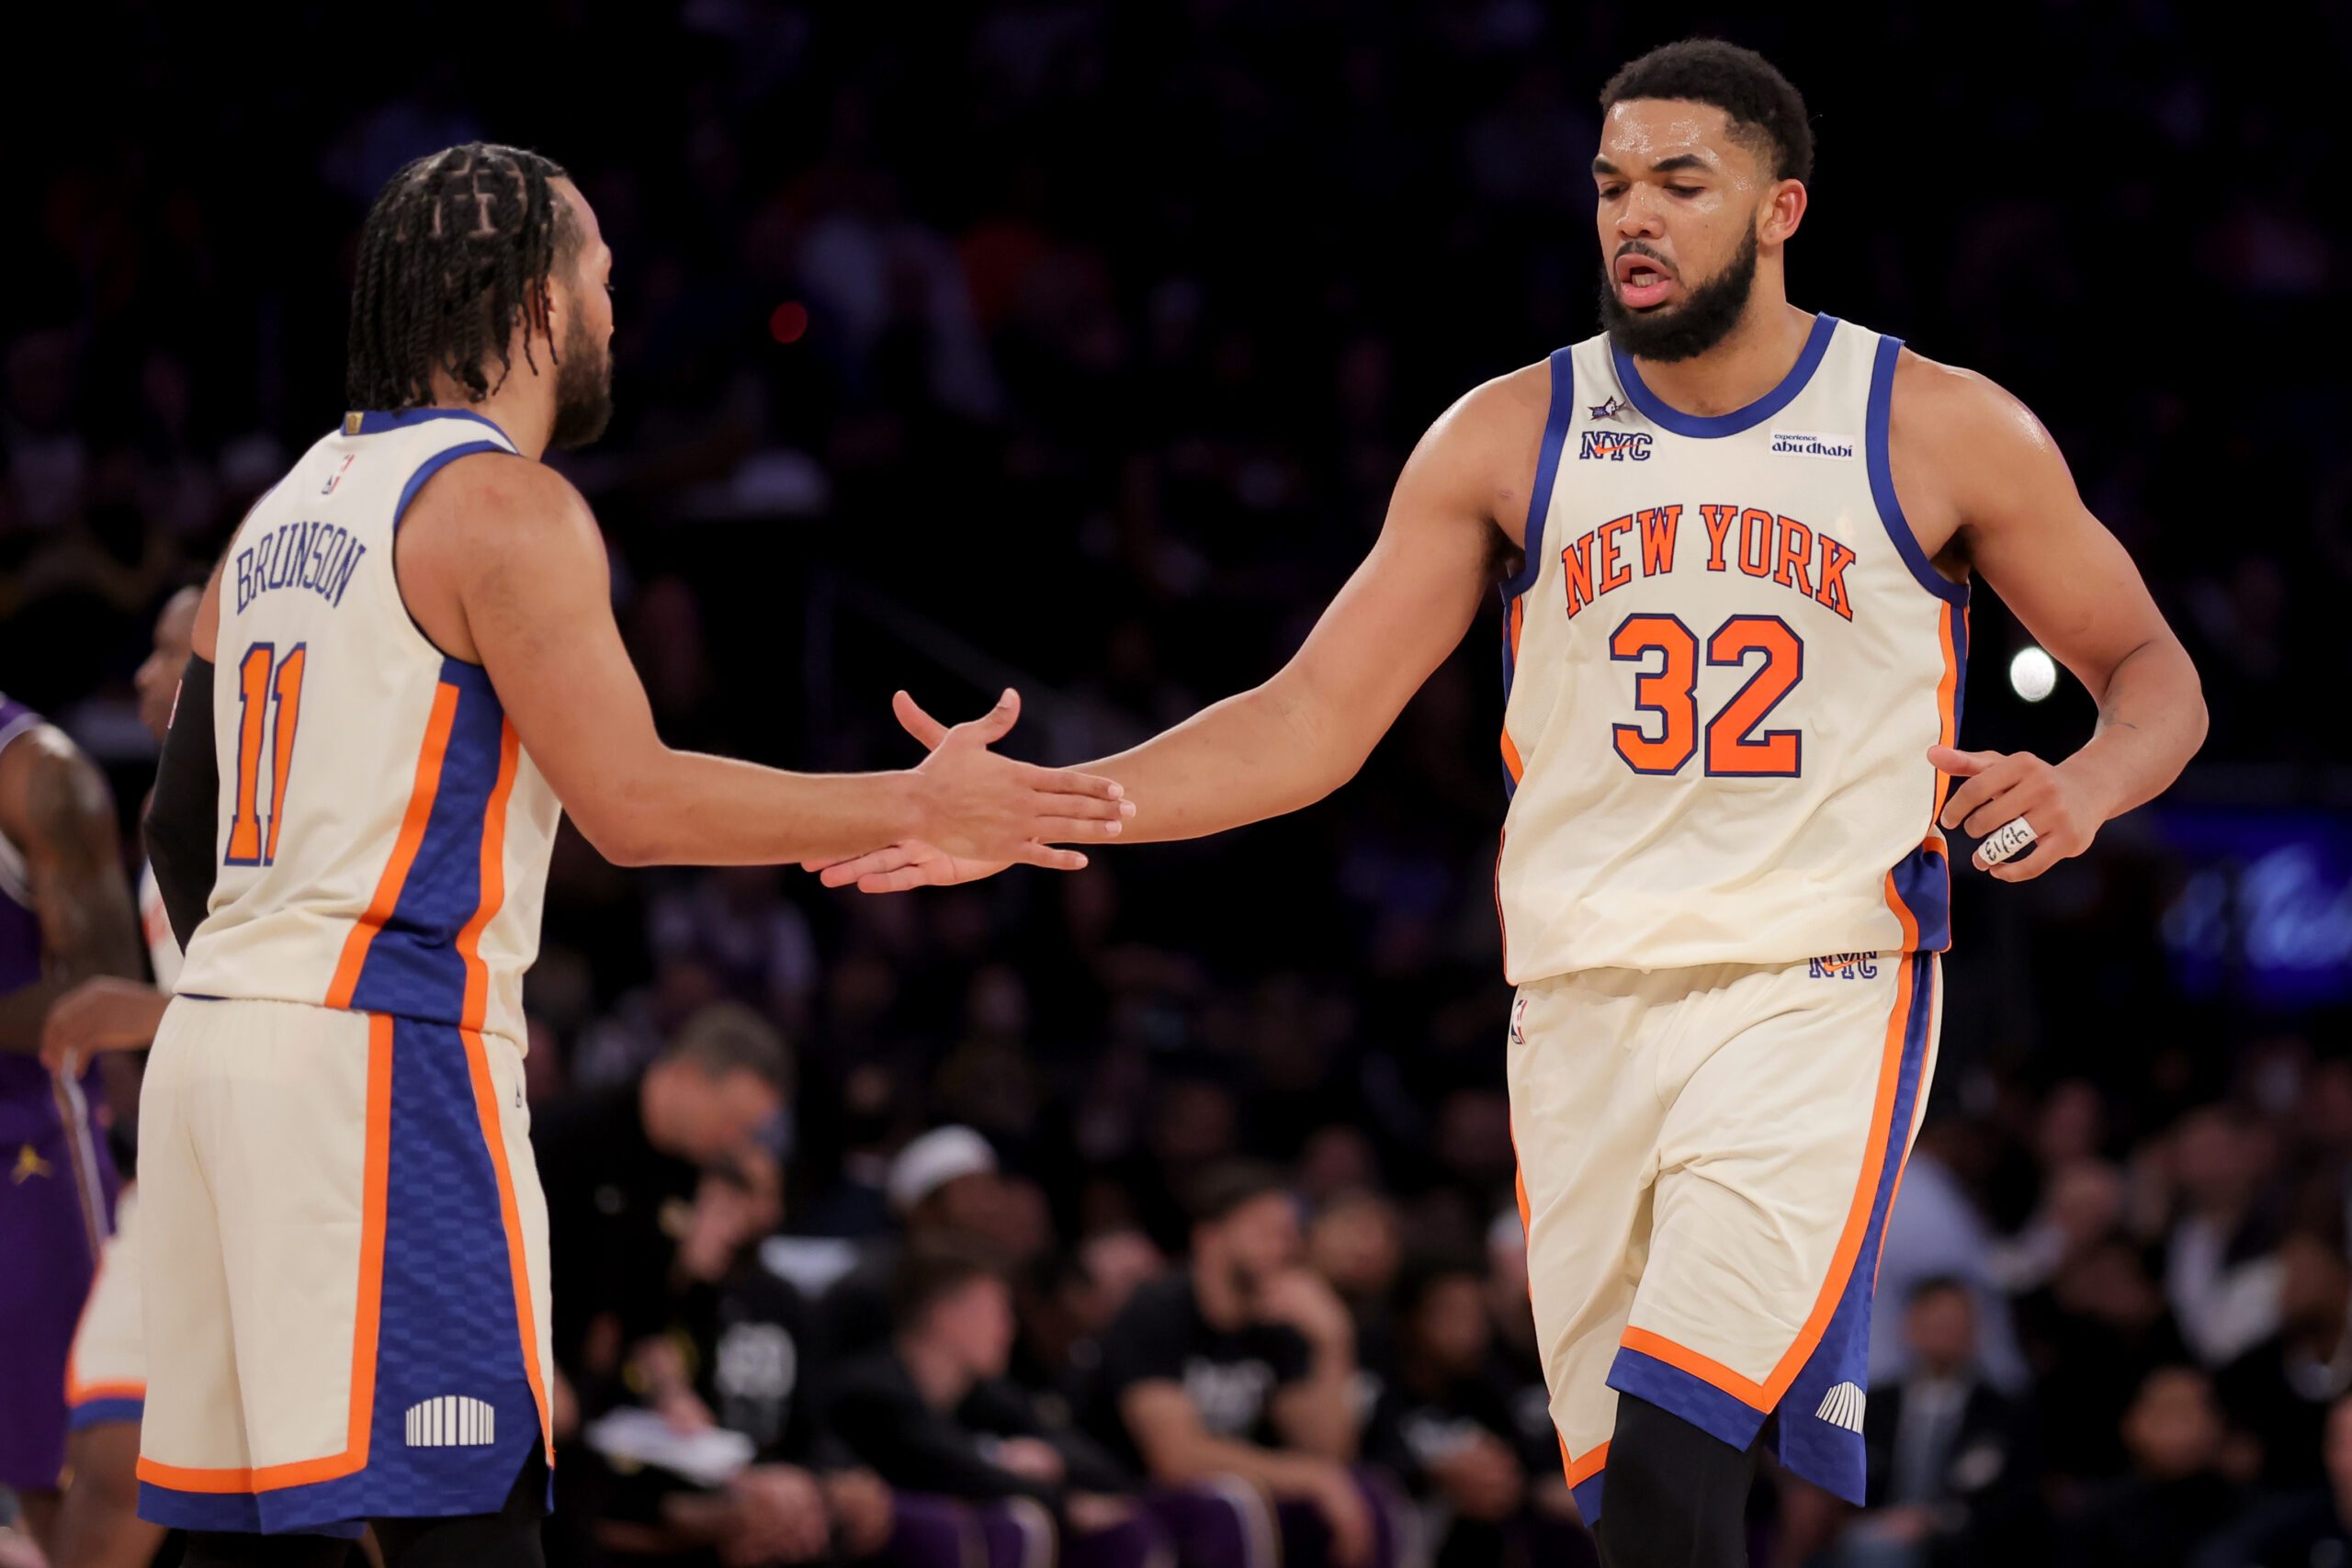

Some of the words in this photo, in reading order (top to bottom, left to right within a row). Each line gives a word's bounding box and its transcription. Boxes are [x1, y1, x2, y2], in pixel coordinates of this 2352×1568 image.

[1579, 431, 1653, 461] NYC
[1771, 441, 1803, 453] abu
[236, 521, 367, 616] BRUNSON
[1562, 504, 1683, 620] NEW
[1700, 504, 1856, 622] YORK
[1609, 614, 1804, 778] 32
[223, 641, 307, 867] 11
[1809, 950, 1878, 980] NYC
